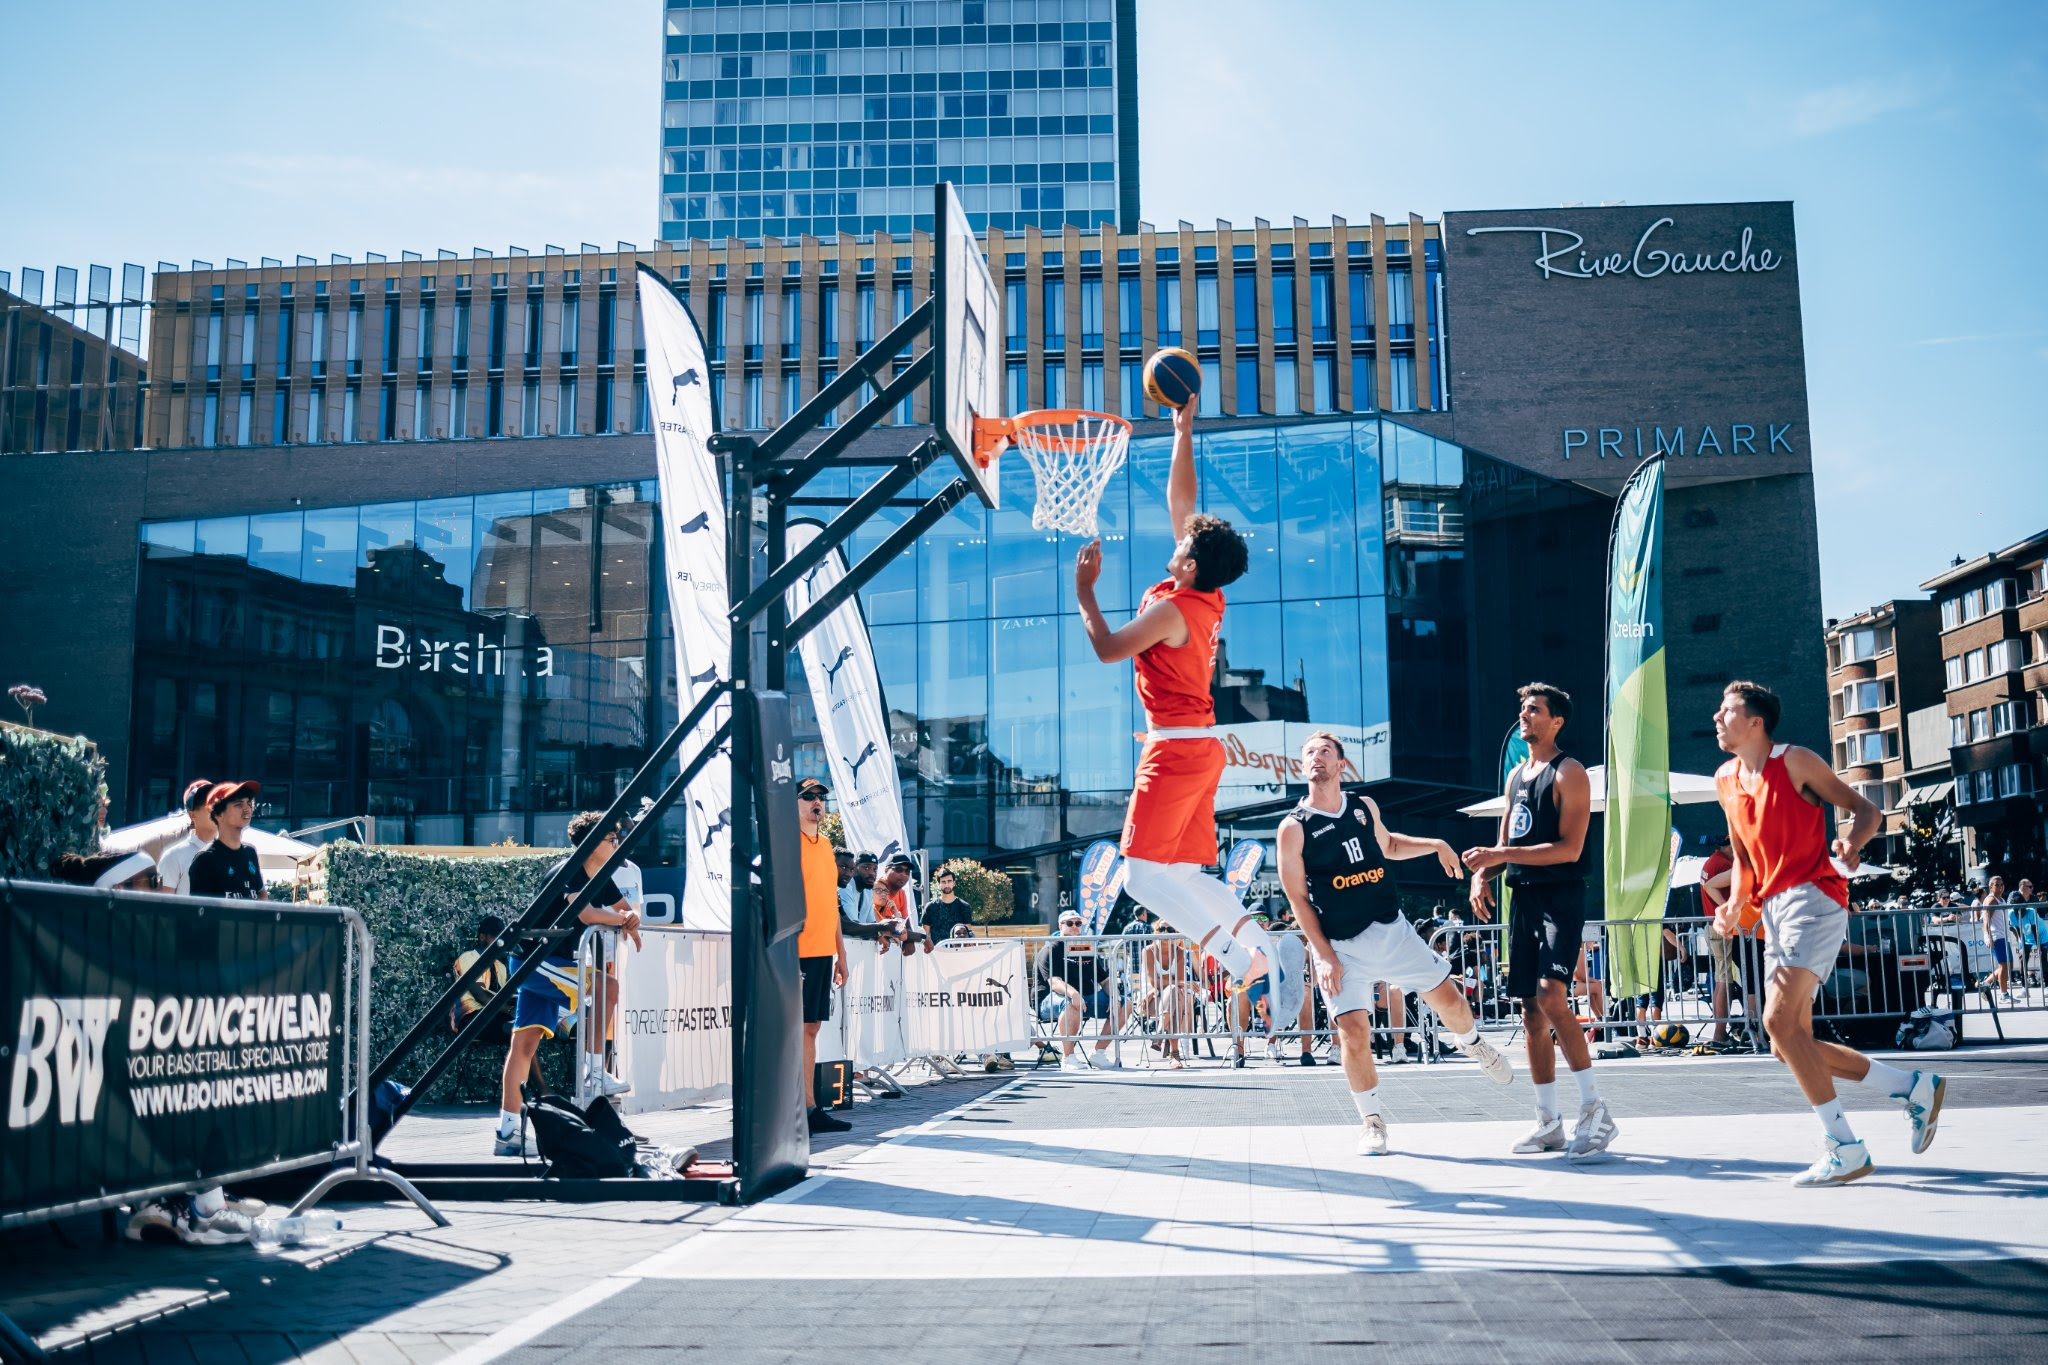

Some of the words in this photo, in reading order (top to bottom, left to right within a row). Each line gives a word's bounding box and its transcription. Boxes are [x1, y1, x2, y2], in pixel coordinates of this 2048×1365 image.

[1563, 423, 1794, 460] PRIMARK
[1001, 617, 1049, 630] ZARA
[1613, 618, 1655, 639] Crelan
[376, 624, 554, 677] Bersha
[1342, 837, 1365, 865] 18
[1332, 867, 1385, 890] Orange
[957, 991, 1004, 1008] PUMA
[127, 992, 333, 1051] BOUNCEWEAR
[8, 997, 122, 1129] BW
[127, 1052, 164, 1079] YOUR
[166, 1048, 239, 1075] BASKETBALL
[240, 1045, 303, 1068] SPECIALTY
[305, 1041, 329, 1063] STORE
[129, 1067, 328, 1119] WWW.BOUNCEWEAR.COM
